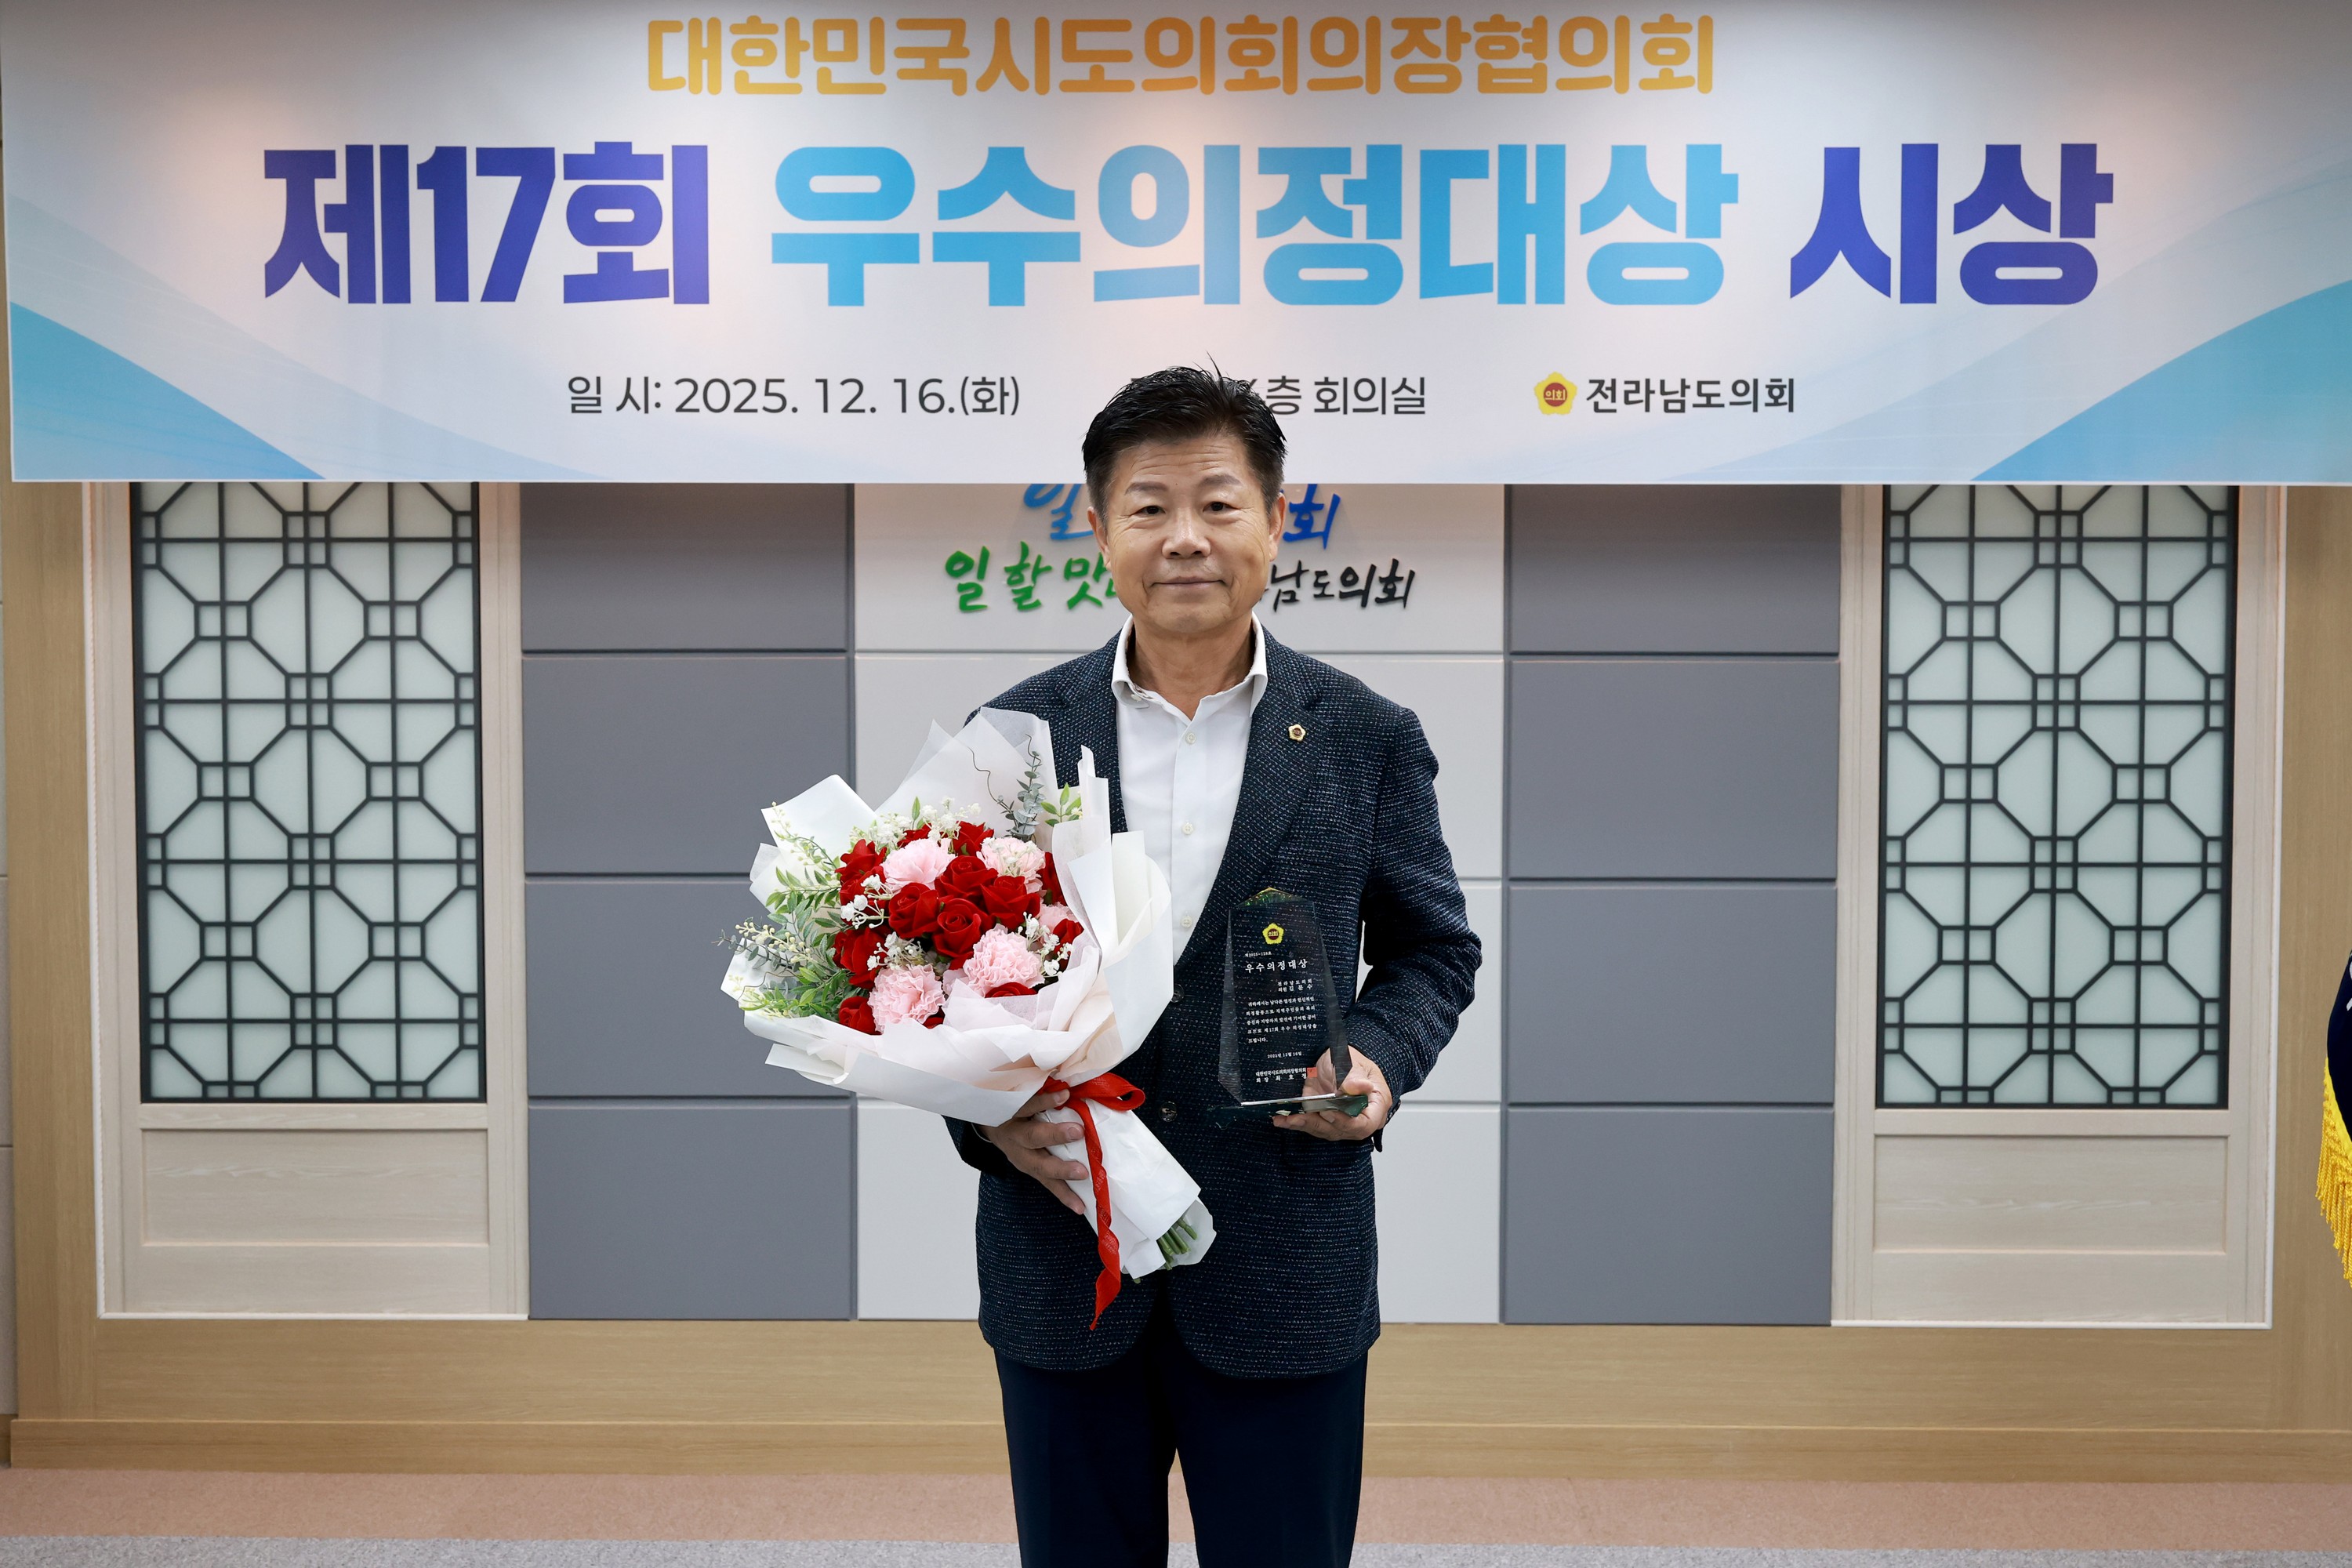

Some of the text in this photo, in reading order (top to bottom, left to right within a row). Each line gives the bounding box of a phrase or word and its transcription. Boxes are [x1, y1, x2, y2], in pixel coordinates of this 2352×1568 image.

[649, 14, 1713, 96] 대한민국시도의회의장협의회
[267, 142, 2112, 307] 제17회 우수의정대상 시상
[674, 378, 798, 414] 2025.
[815, 378, 877, 414] 12.
[894, 376, 1019, 416] 16.(화)
[1314, 376, 1425, 416] 회의실
[1544, 389, 1566, 401] 의회
[1586, 378, 1795, 414] 전라남도의회
[1260, 558, 1416, 613] 남도의회
